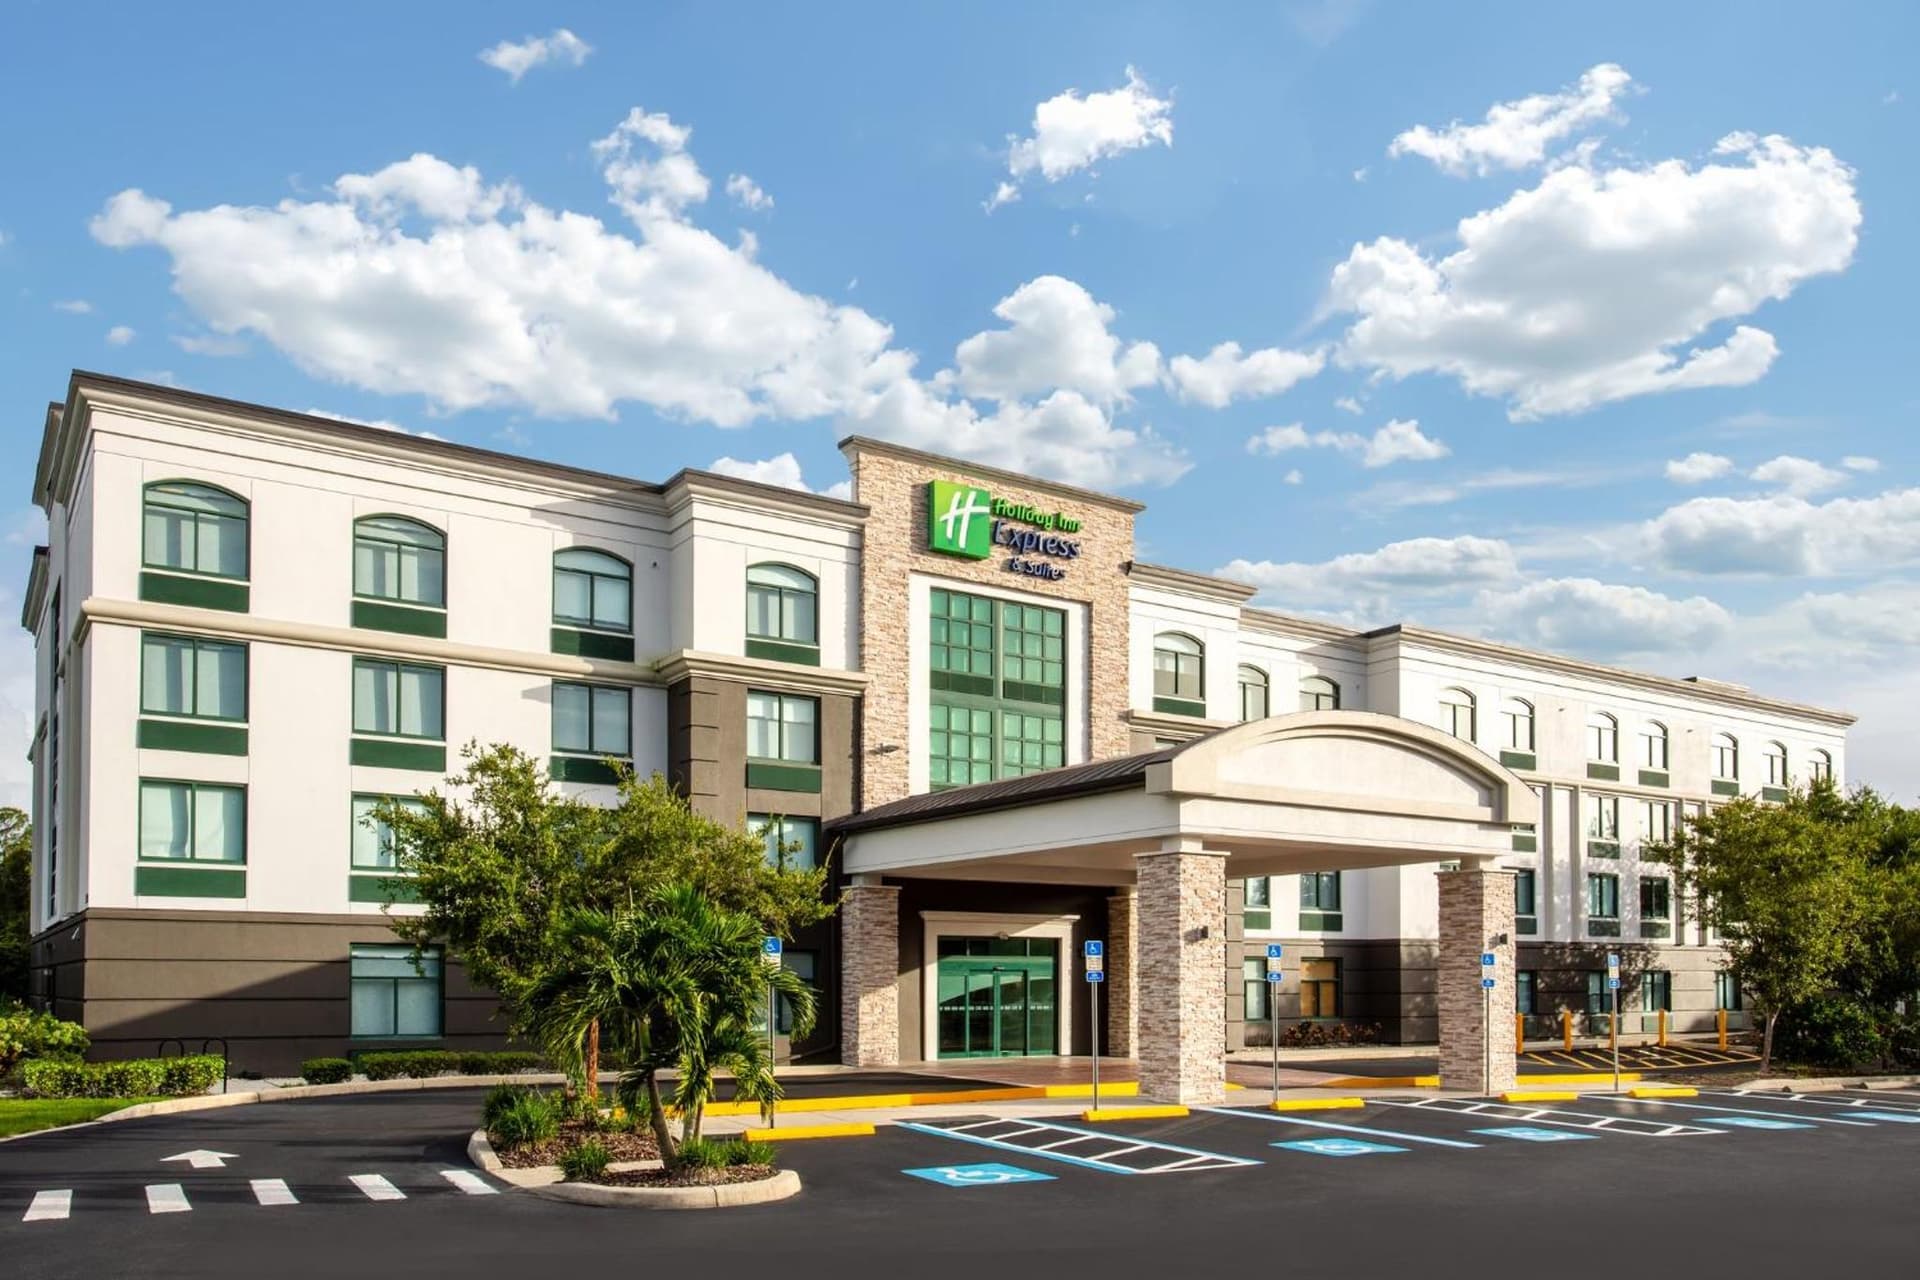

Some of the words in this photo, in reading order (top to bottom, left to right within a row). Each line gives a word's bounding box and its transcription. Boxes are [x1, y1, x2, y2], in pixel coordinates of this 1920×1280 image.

[994, 498, 1054, 531] Holiday
[1057, 512, 1080, 532] Inn
[994, 520, 1080, 559] Express
[1010, 557, 1021, 571] &
[1024, 560, 1065, 580] Suites
